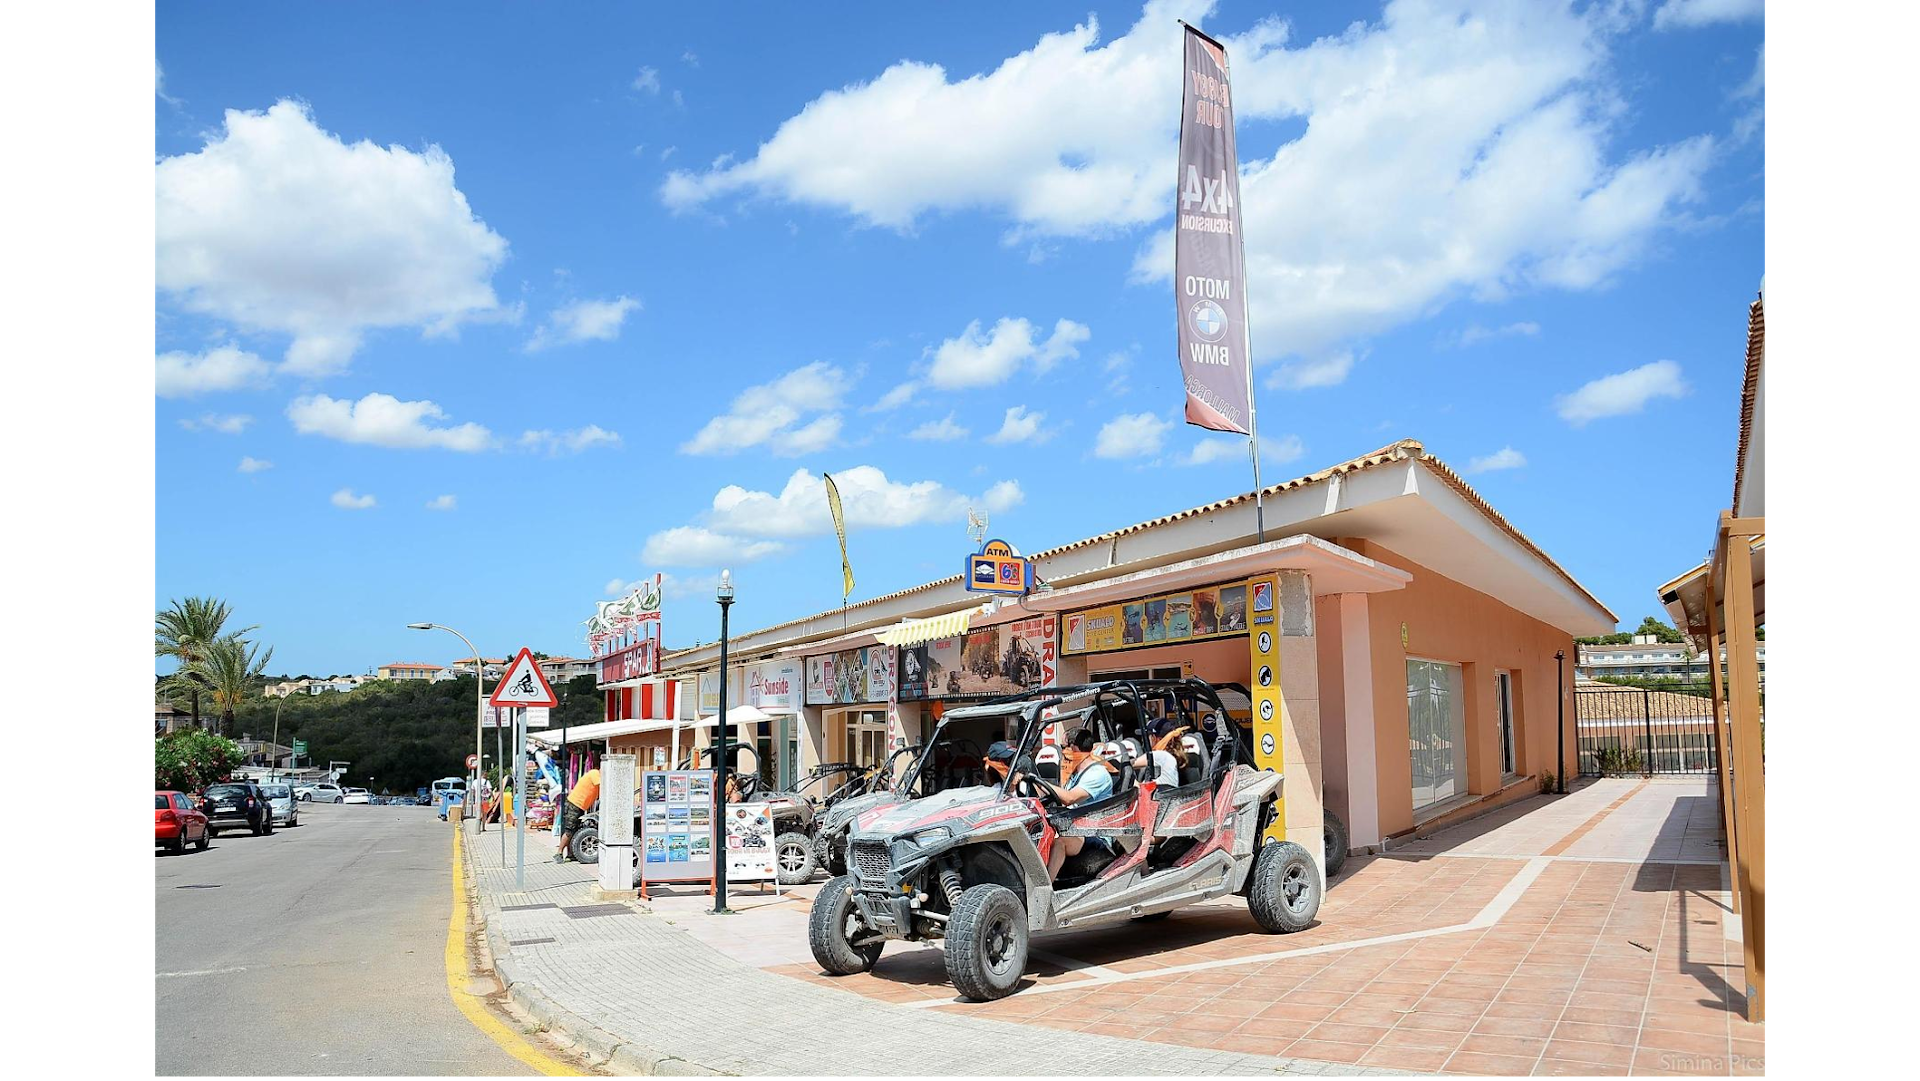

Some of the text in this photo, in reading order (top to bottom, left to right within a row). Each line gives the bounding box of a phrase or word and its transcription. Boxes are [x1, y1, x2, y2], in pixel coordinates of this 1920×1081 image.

[986, 548, 1009, 557] ATM
[1086, 616, 1115, 631] SKUALO
[623, 647, 646, 680] SPAR
[764, 677, 789, 696] Sunside
[888, 644, 896, 751] DRAGON
[979, 803, 1022, 819] 900
